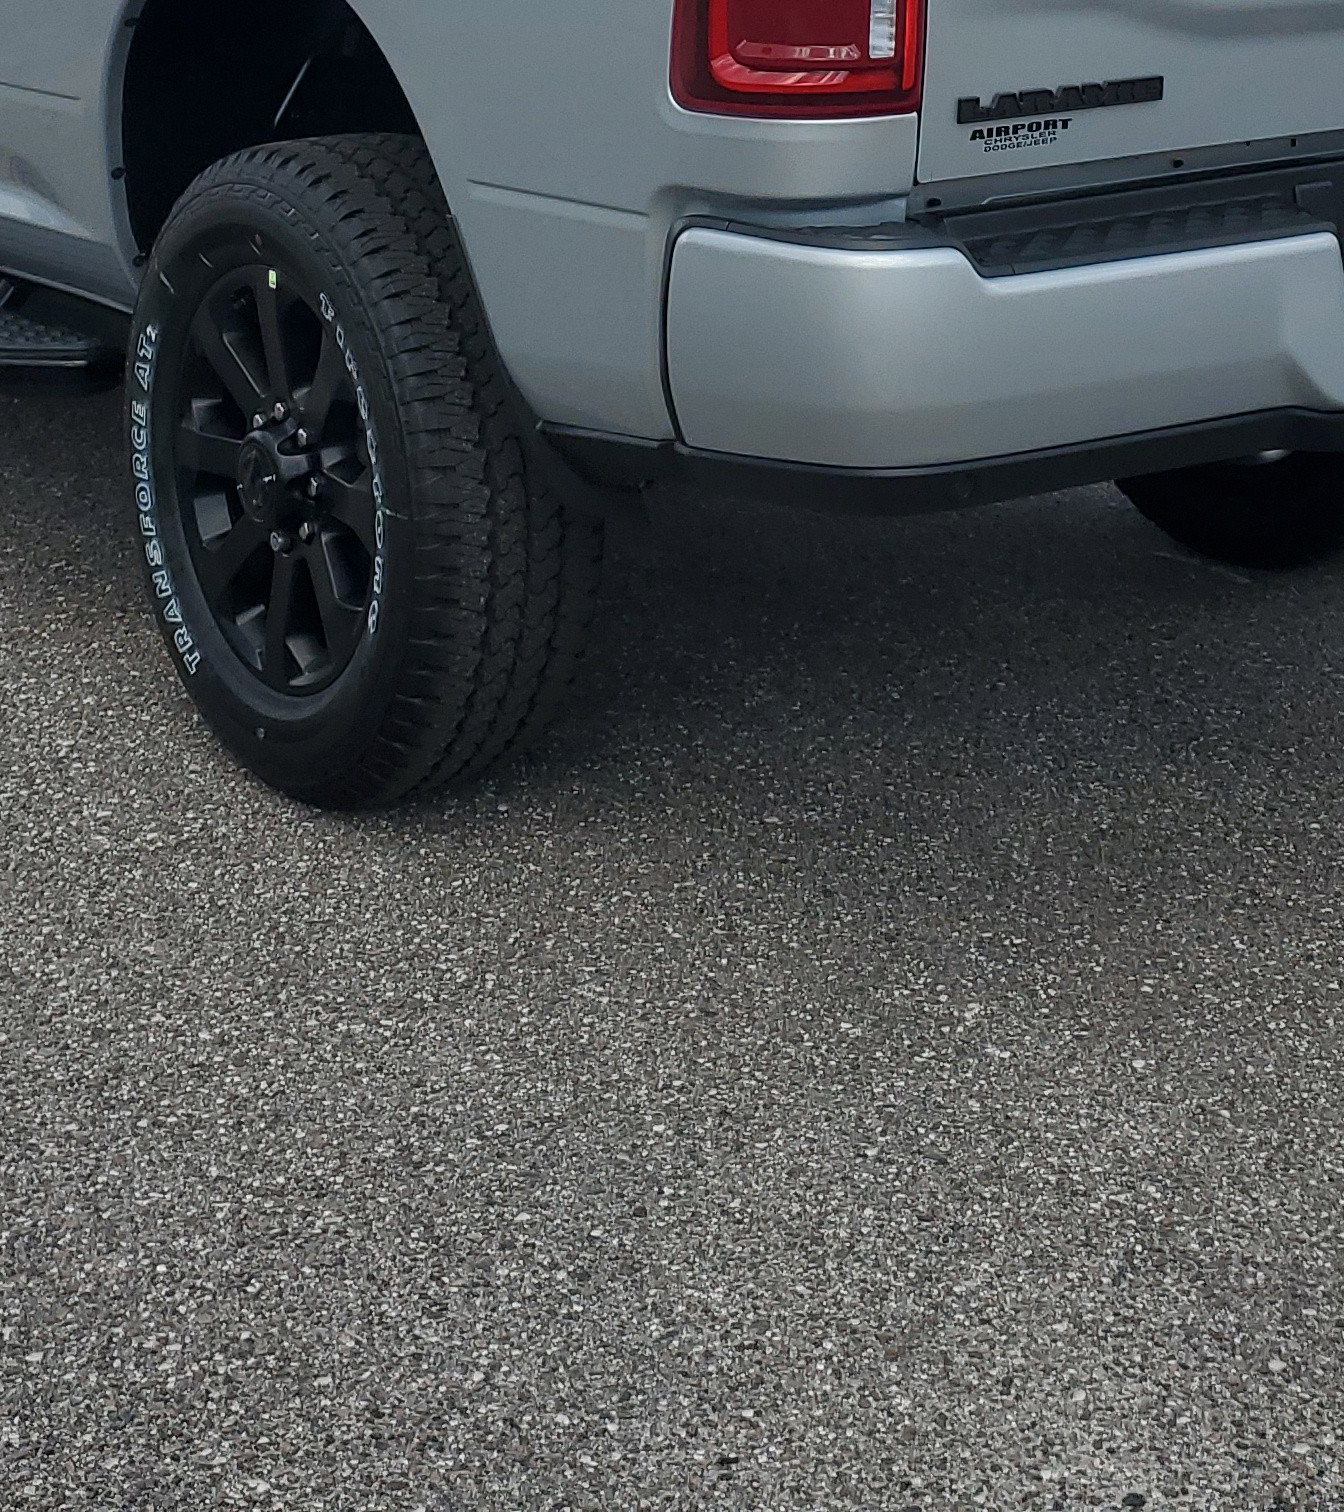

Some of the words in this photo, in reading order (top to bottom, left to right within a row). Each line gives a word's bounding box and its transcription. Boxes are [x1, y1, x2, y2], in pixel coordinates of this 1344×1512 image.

[956, 75, 1164, 125] LARAMIE
[969, 117, 1073, 141] AIRPORT
[984, 130, 1057, 146] CHRYSLER
[983, 136, 1058, 153] DODGE/JEEP
[130, 400, 201, 676] TRANSFORCE
